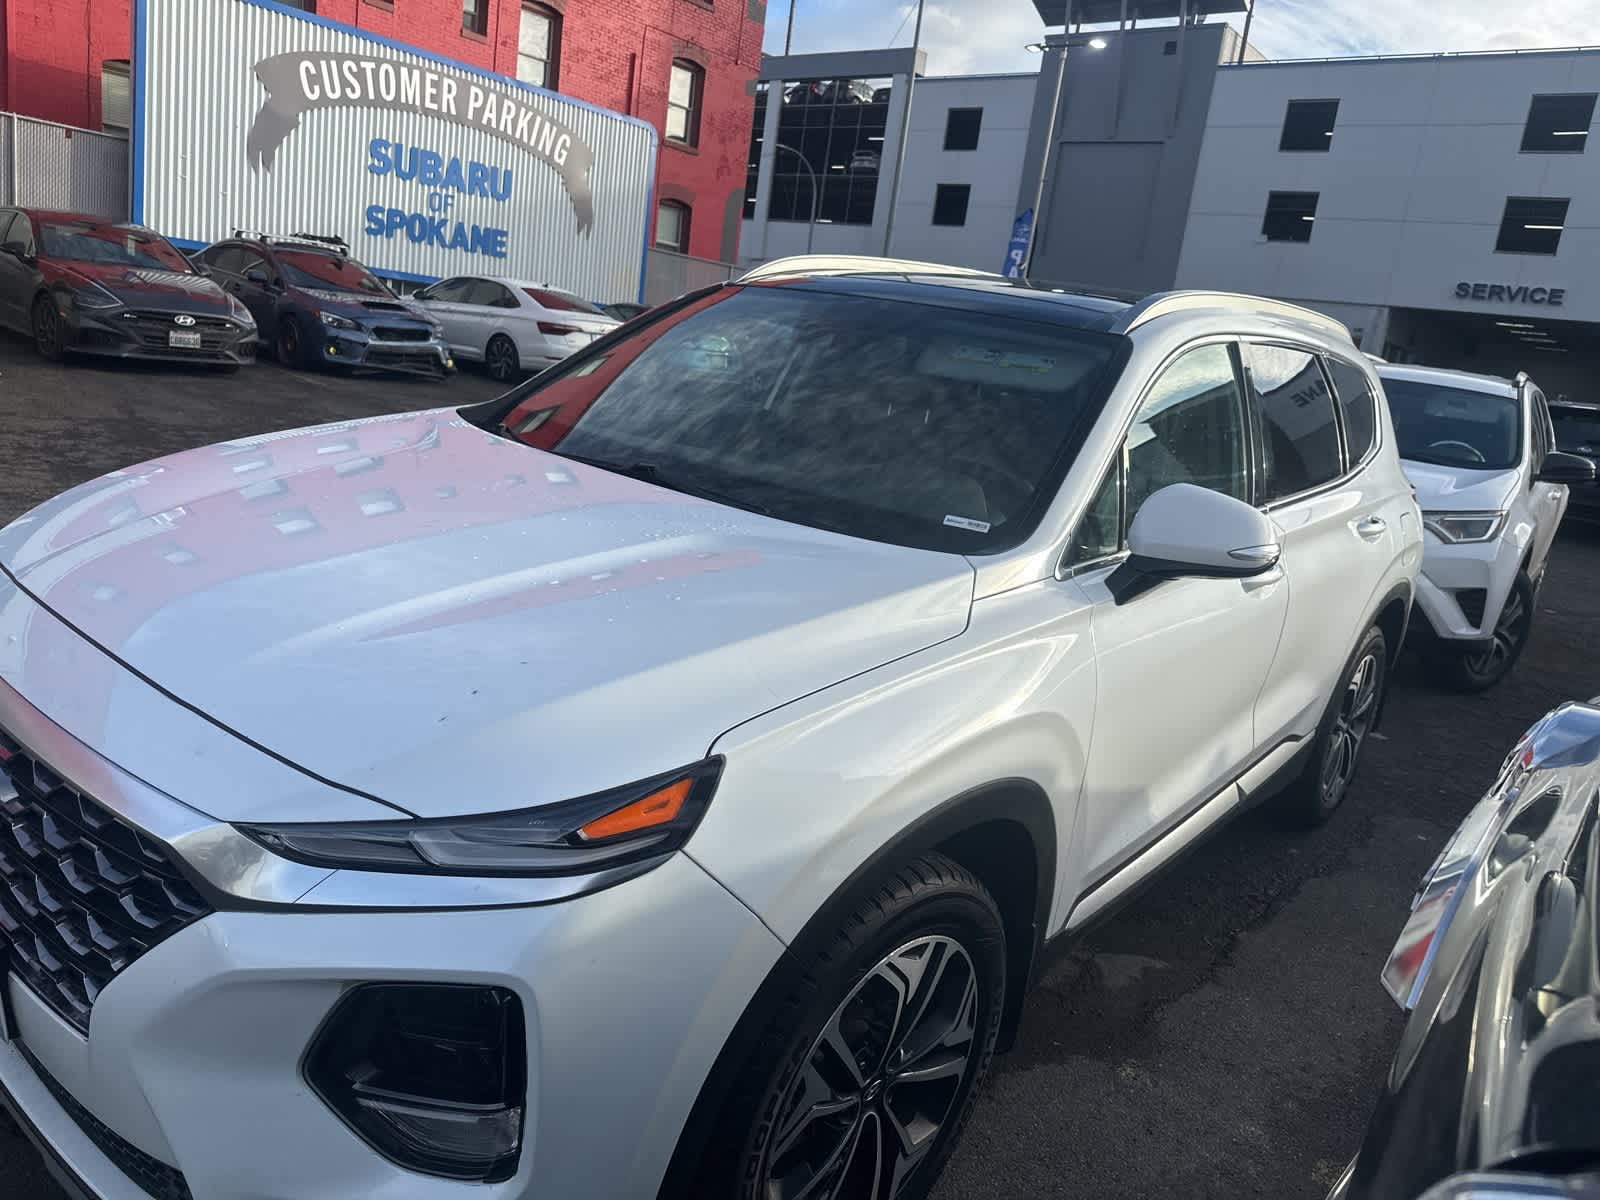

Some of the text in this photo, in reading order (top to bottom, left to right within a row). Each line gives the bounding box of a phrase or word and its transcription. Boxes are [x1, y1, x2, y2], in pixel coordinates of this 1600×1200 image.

[299, 59, 572, 166] CUSTOMER PARKING
[368, 138, 513, 202] SUBARU
[429, 192, 456, 214] OF
[365, 204, 509, 259] SPOKANE
[1455, 282, 1566, 306] SERVICE
